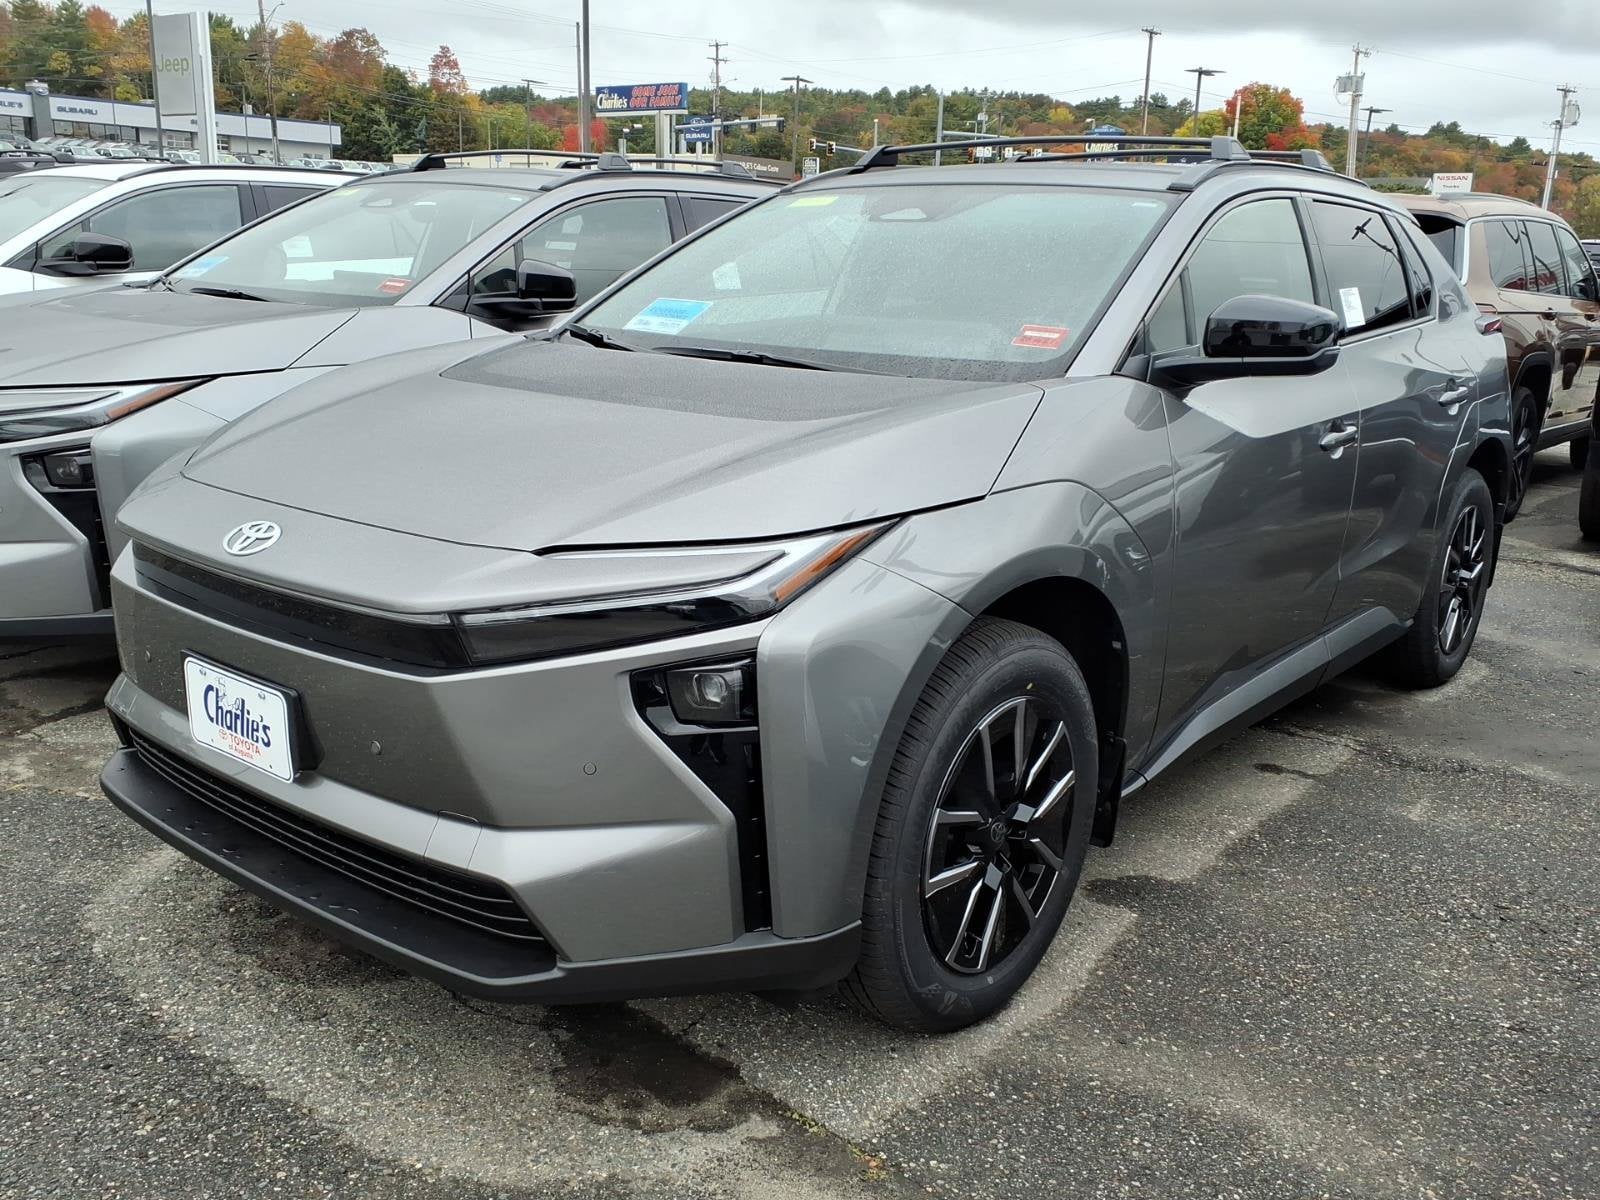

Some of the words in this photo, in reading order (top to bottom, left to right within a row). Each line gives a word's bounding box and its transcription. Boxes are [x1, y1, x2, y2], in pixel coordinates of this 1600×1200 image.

[158, 53, 190, 76] Jeep
[57, 105, 98, 116] SUBARU
[597, 93, 628, 109] Charlie's
[203, 684, 271, 748] Charlie's
[229, 733, 262, 756] TOYOTA
